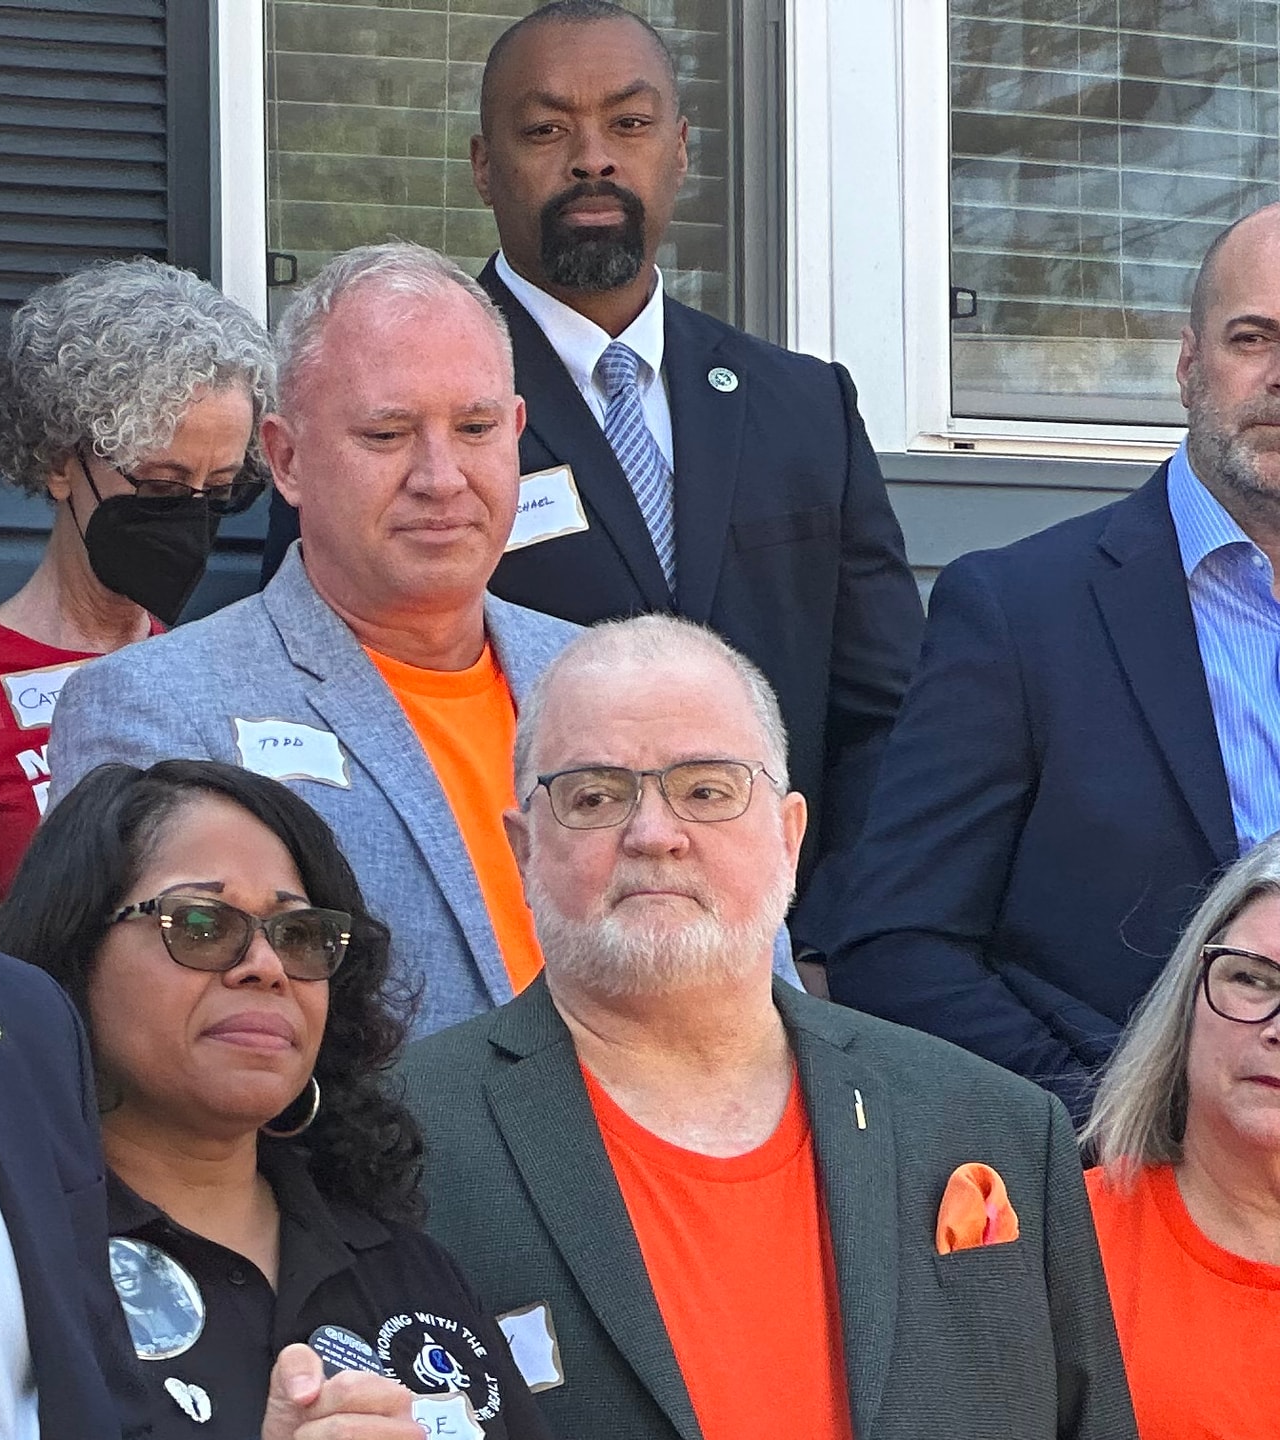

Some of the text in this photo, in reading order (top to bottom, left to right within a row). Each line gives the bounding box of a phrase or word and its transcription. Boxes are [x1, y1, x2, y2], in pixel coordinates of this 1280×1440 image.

[516, 496, 555, 513] CHAEL
[18, 687, 62, 709] CAT
[376, 1313, 413, 1361] WORKING
[414, 1311, 458, 1333] WITH
[462, 1326, 488, 1359] THE
[416, 1416, 457, 1435] SE
